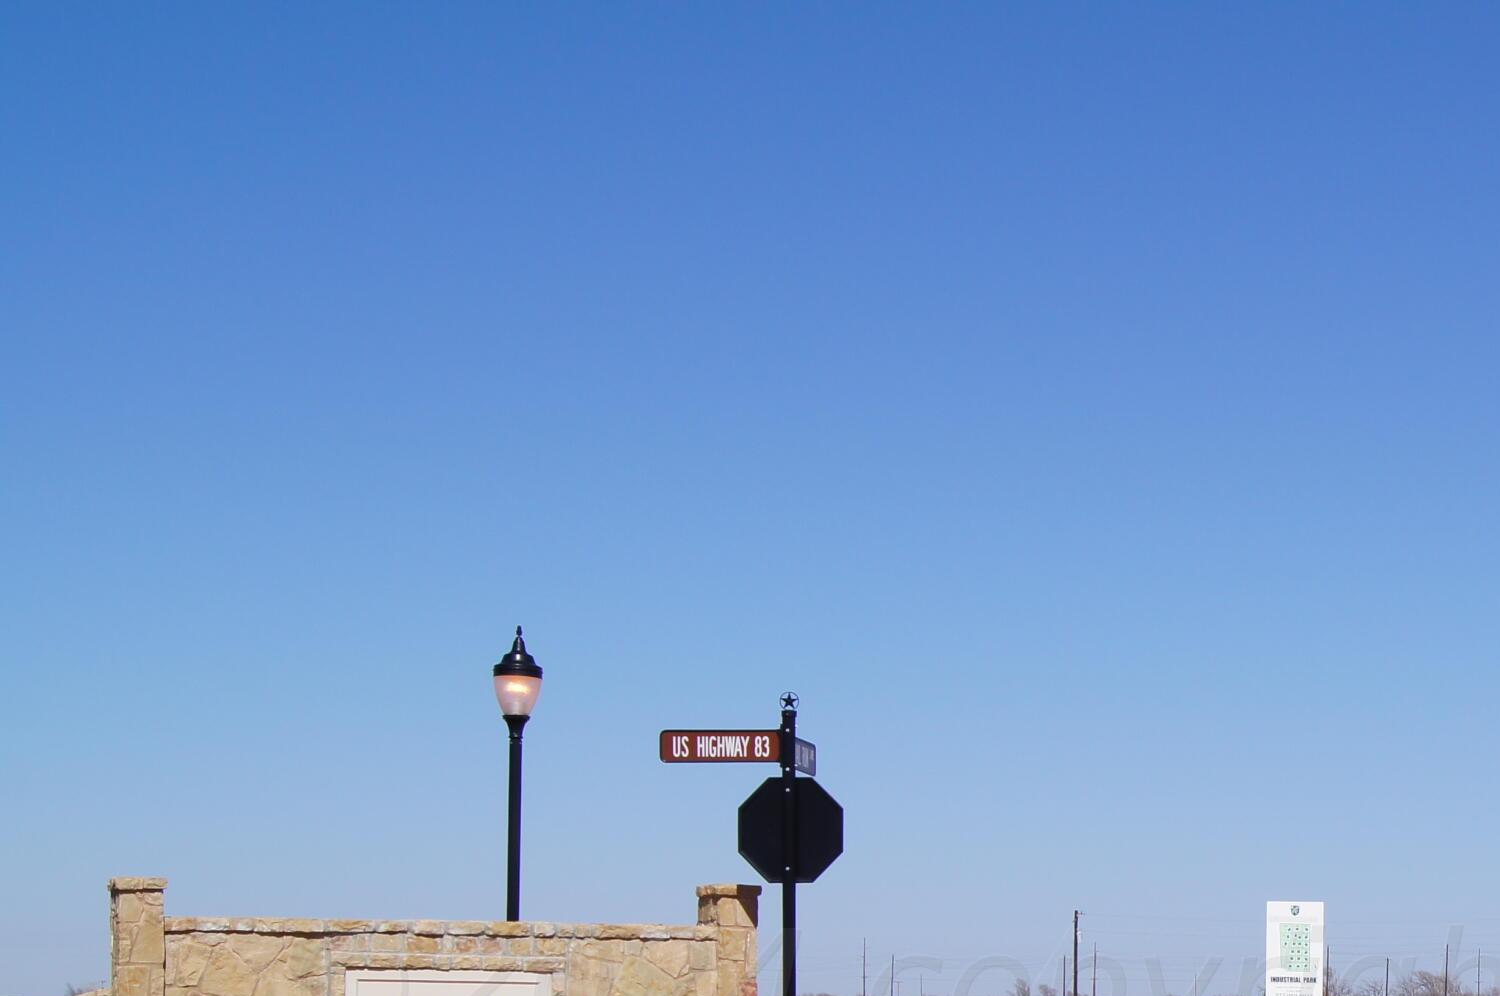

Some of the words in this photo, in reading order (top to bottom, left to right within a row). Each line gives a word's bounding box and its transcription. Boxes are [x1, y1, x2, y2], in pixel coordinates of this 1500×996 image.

[672, 736, 689, 757] US
[697, 736, 750, 757] HIGHWAY
[754, 736, 770, 757] 83
